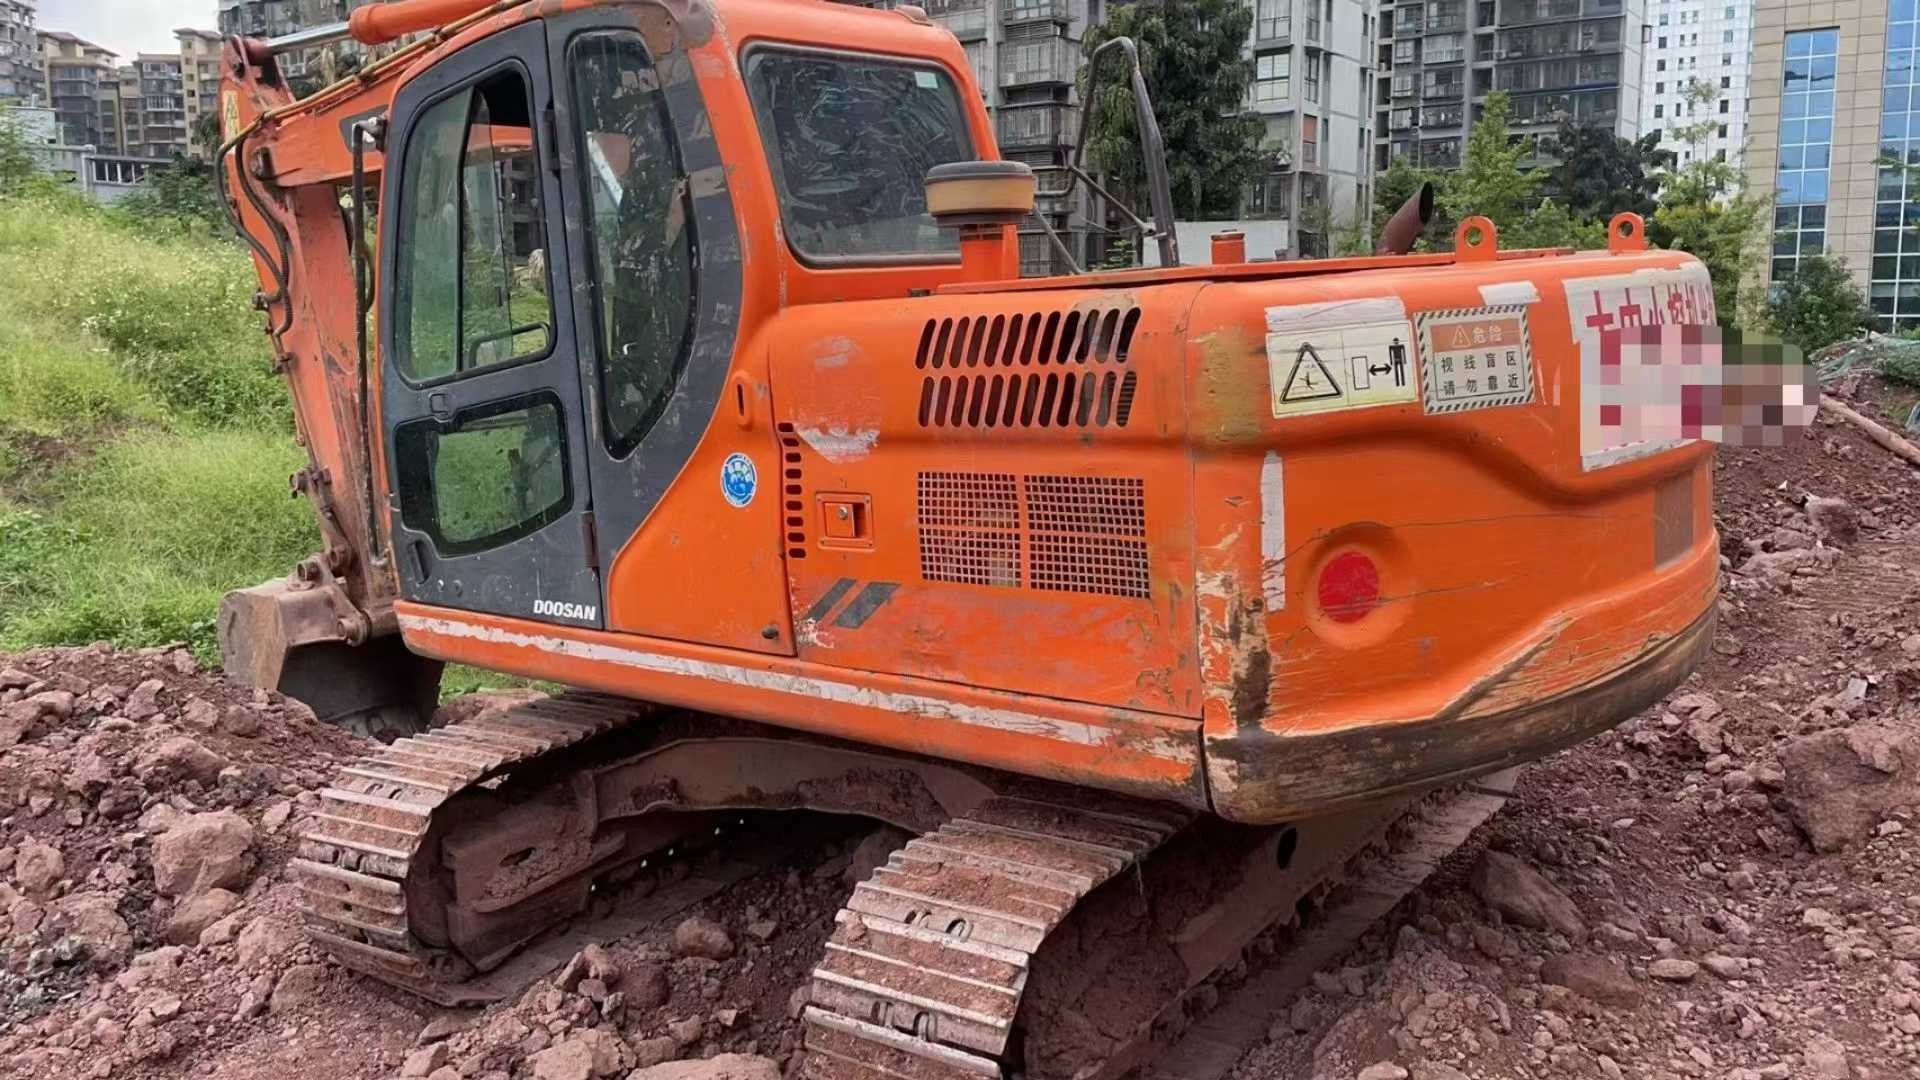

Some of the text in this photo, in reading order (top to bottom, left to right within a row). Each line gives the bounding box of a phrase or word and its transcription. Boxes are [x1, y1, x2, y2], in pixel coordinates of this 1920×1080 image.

[1473, 325, 1502, 344] 危险
[1441, 351, 1517, 373] 视线盲区
[1443, 373, 1520, 396] 请勿靠近
[533, 600, 596, 620] DOOSAN
